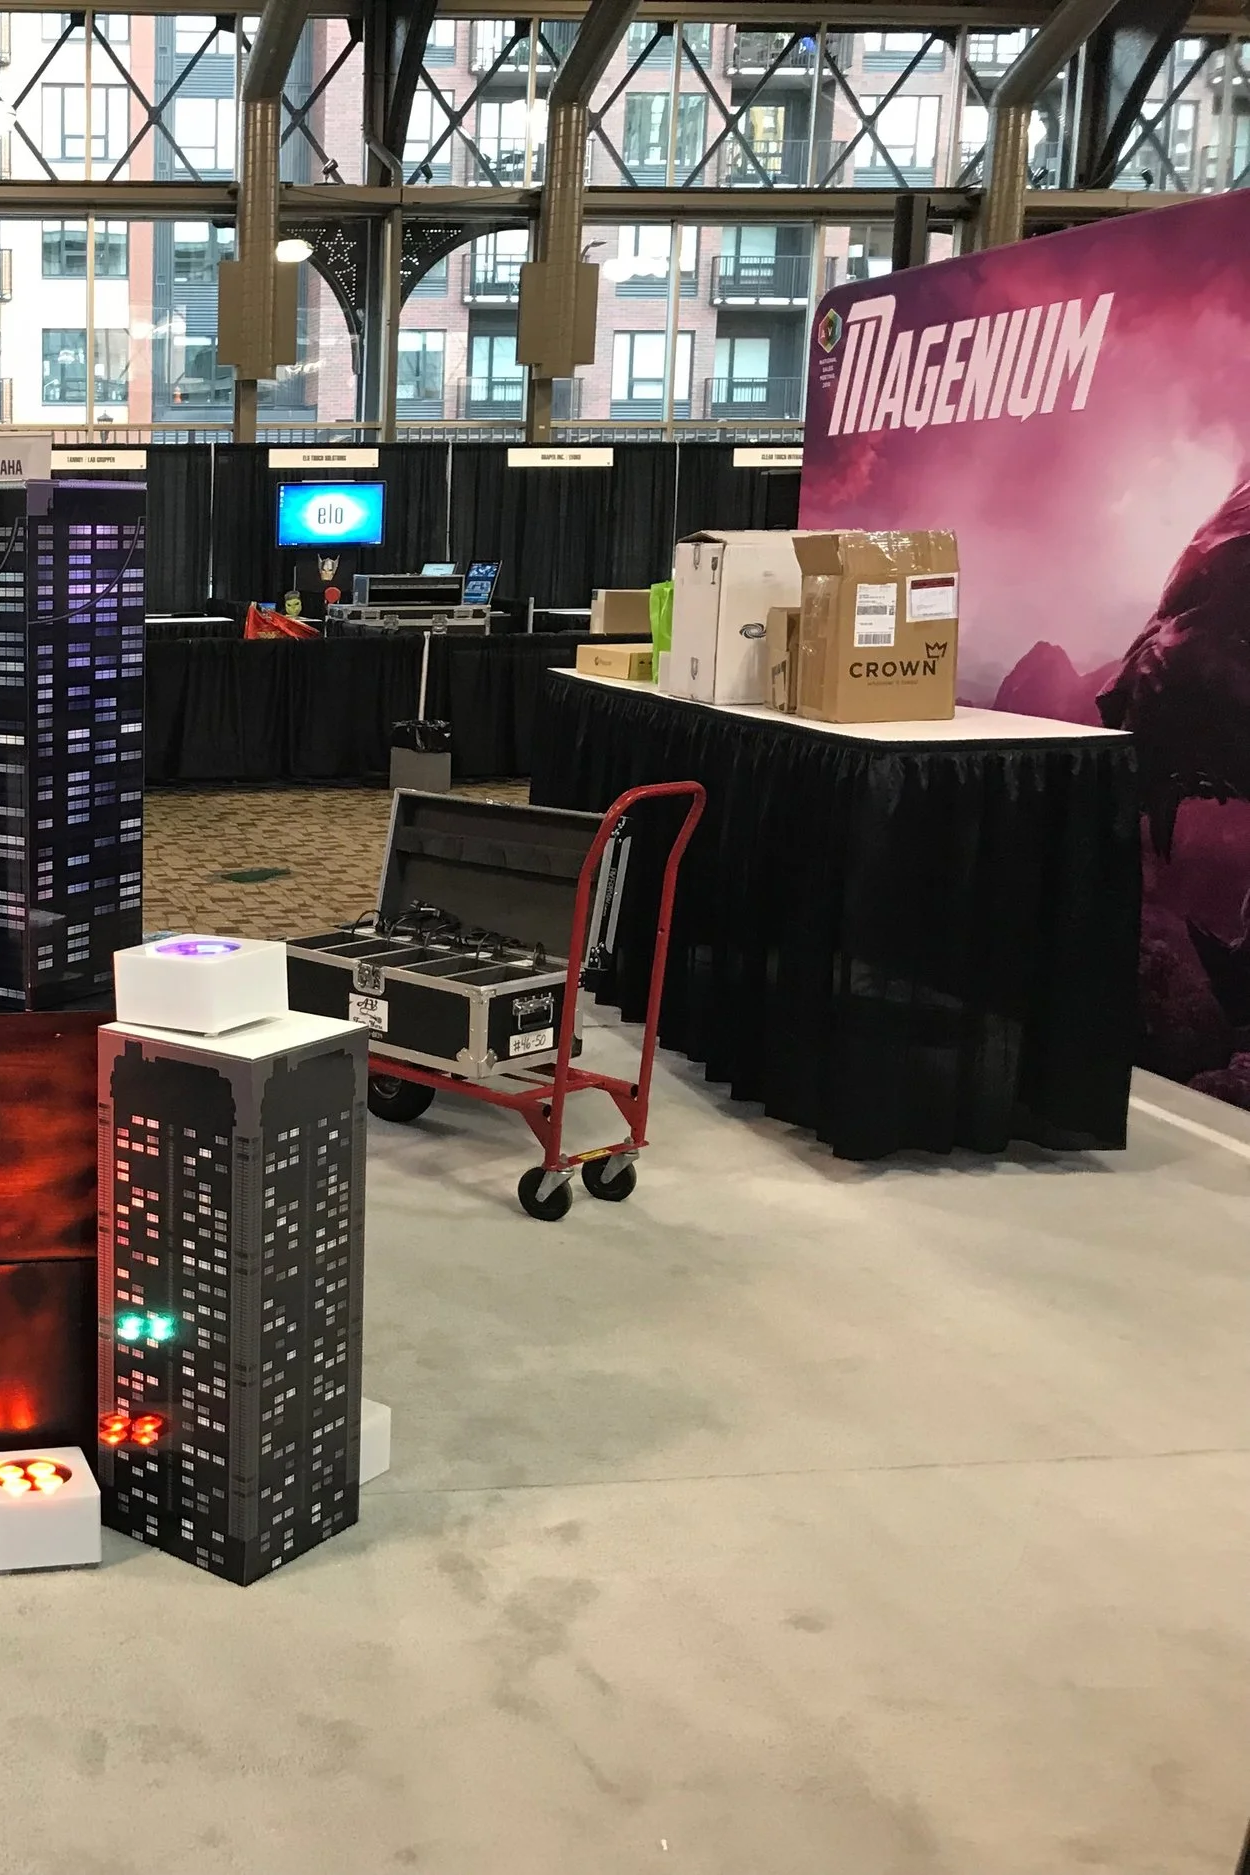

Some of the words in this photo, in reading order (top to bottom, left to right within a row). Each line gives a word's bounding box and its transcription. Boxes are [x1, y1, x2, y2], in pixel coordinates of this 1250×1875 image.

[828, 292, 1115, 436] MAGENIUM
[317, 504, 344, 525] elo
[849, 660, 936, 678] CROWN
